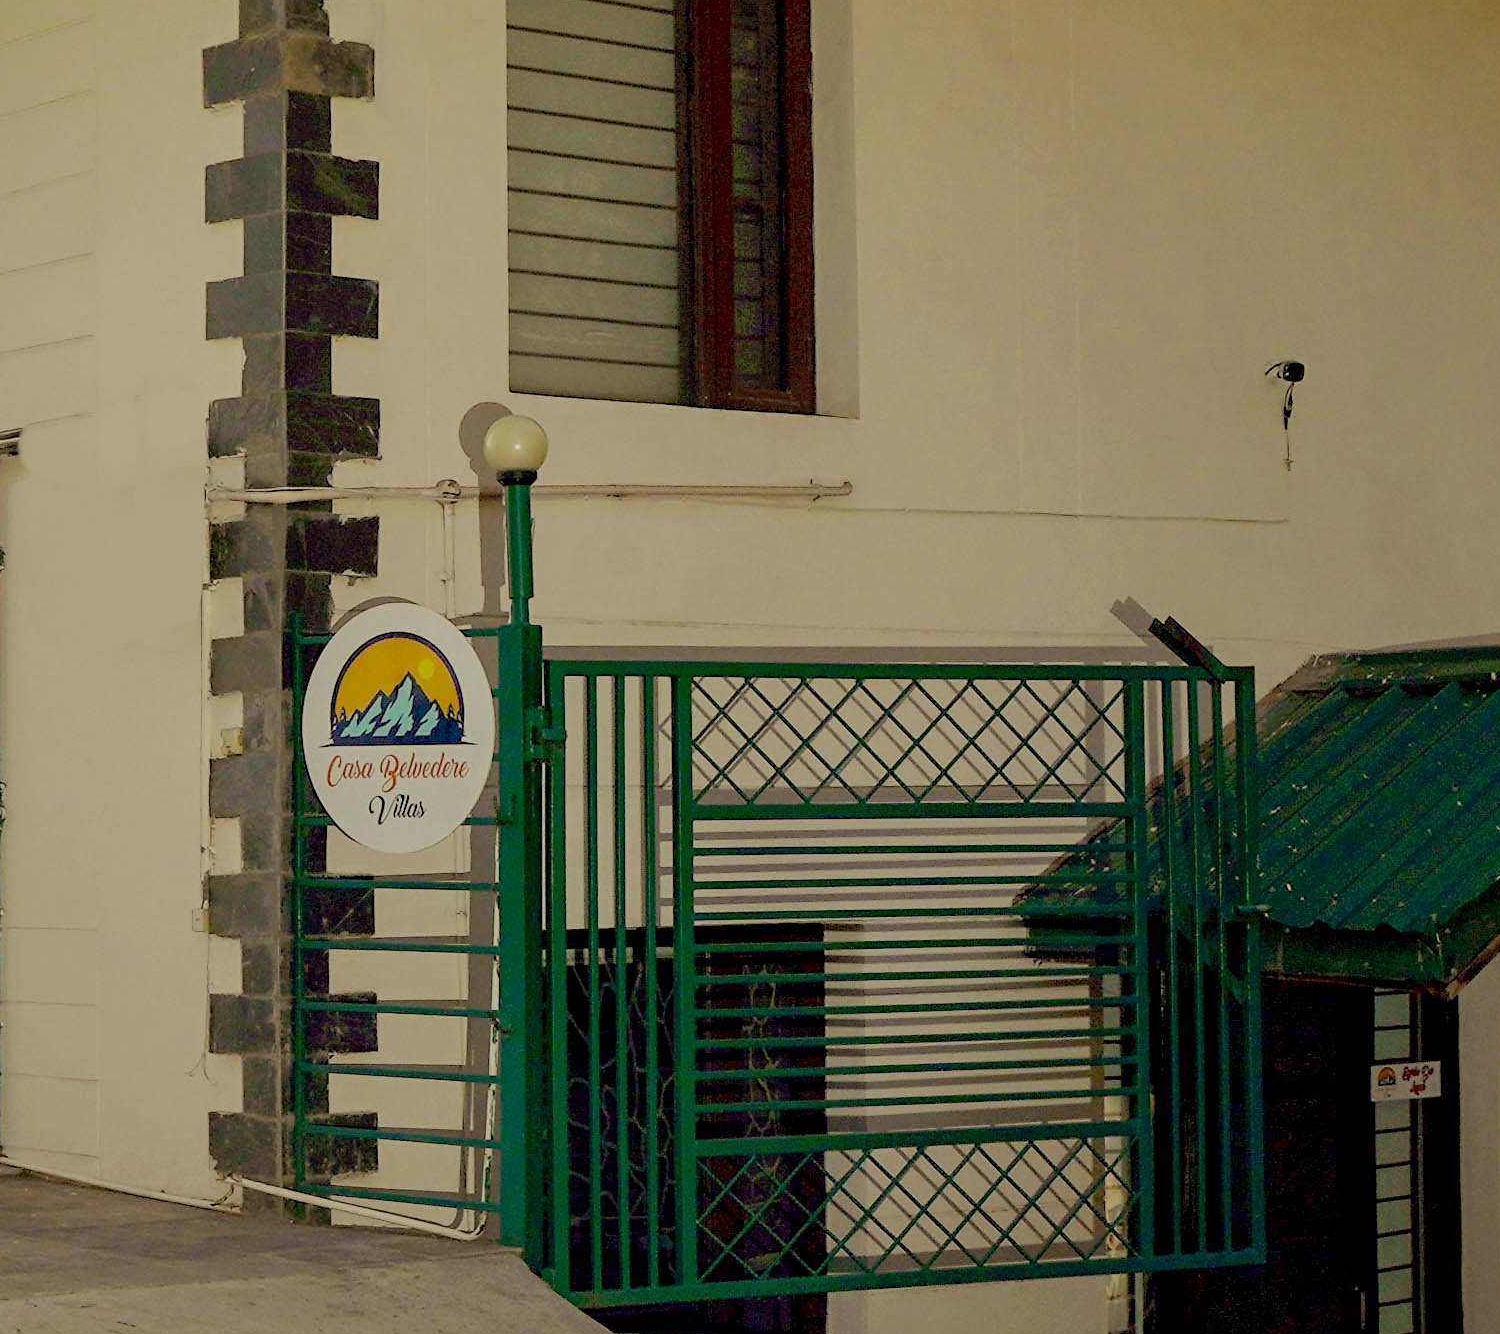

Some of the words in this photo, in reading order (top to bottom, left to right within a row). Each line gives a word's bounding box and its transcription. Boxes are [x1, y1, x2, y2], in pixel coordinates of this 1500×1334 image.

[327, 754, 373, 788] Casa
[380, 752, 470, 793] Belvedere
[369, 794, 426, 825] Villas
